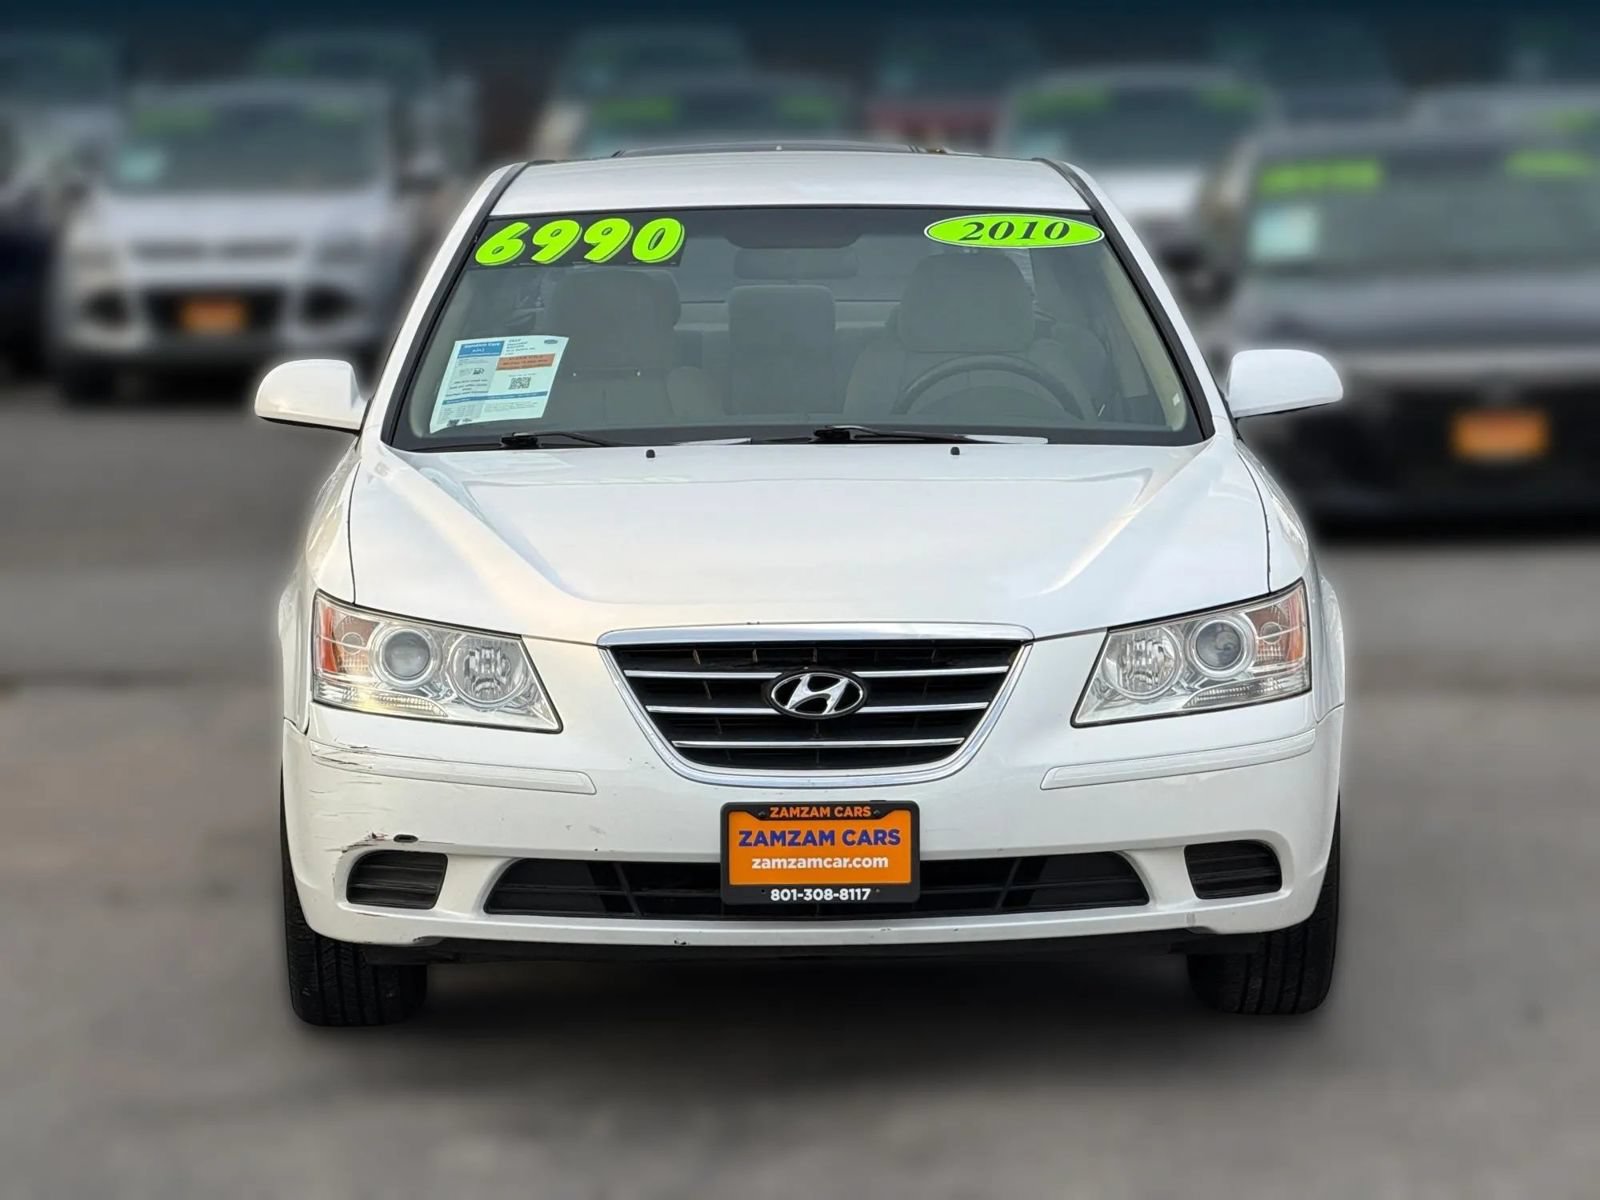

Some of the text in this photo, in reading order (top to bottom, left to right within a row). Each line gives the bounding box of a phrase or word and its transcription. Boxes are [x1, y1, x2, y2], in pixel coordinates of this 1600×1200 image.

[958, 220, 1071, 242] 2010
[474, 217, 686, 267] 6990
[769, 806, 872, 818] ZAMZAM CARS
[738, 829, 901, 847] ZAMZAM CARS
[751, 855, 889, 869] zamzamcar.com
[770, 888, 871, 902] 801-308-8117
